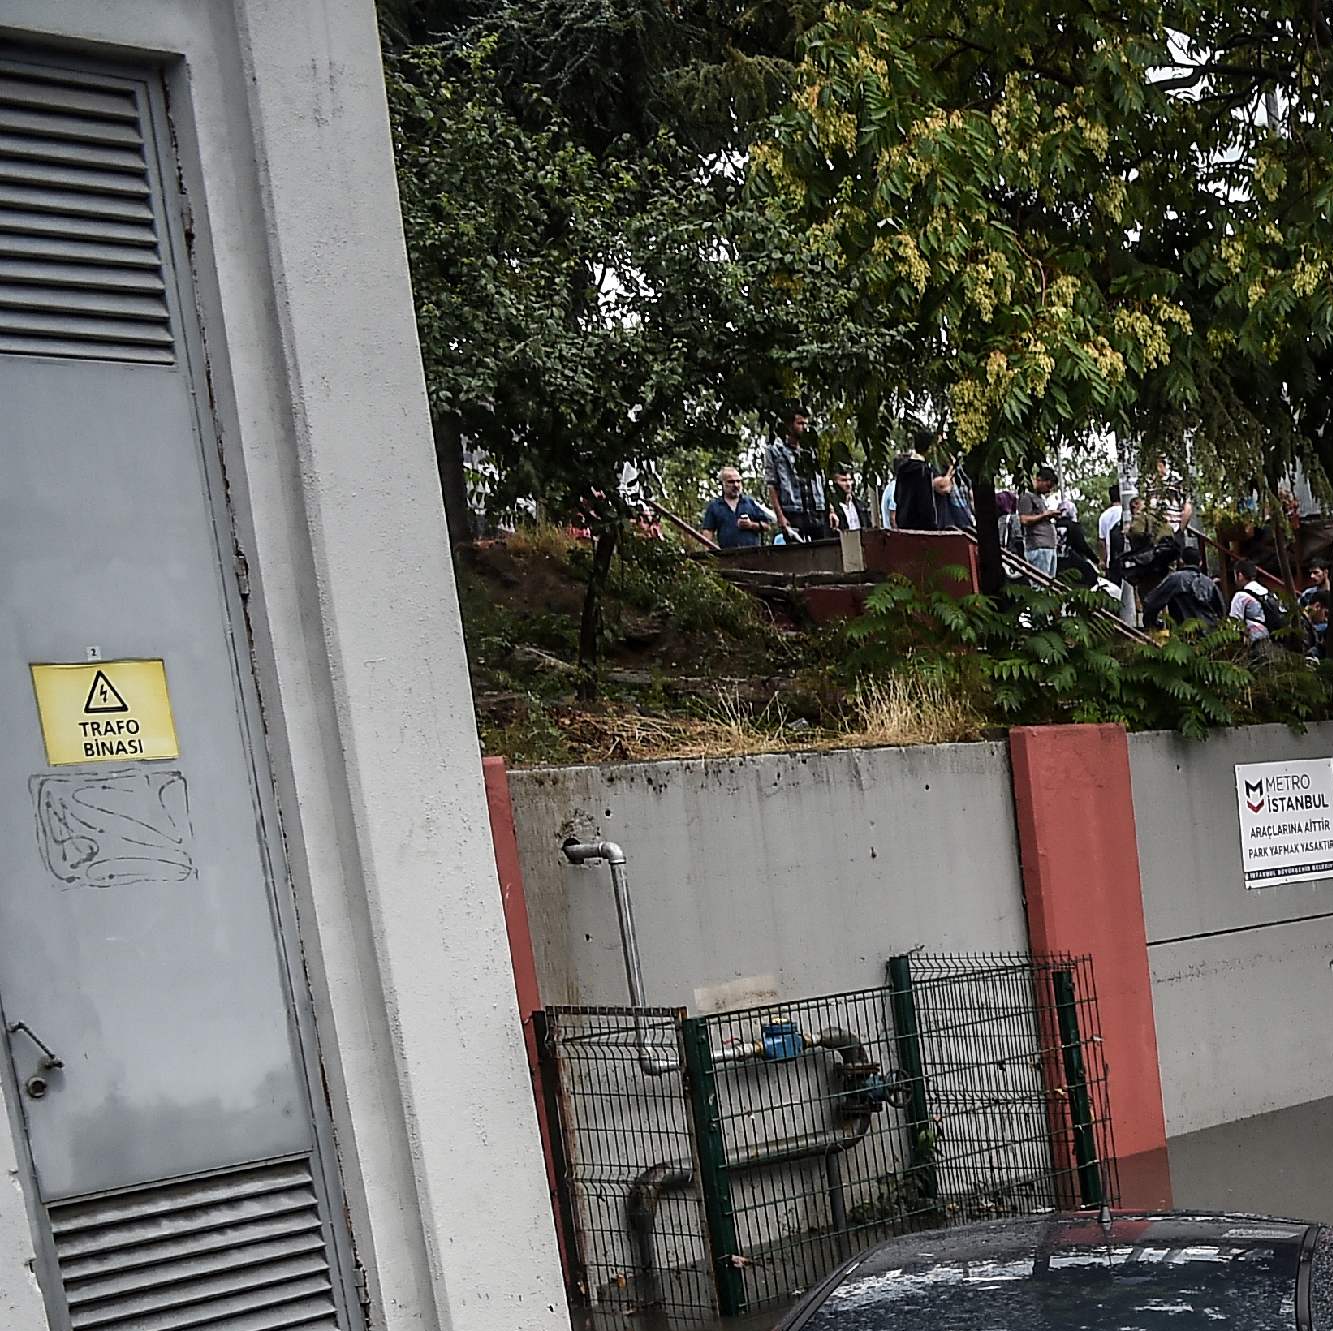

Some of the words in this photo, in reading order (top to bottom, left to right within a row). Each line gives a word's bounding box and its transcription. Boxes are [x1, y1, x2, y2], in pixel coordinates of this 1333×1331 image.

[78, 719, 140, 737] TRAFO
[83, 738, 144, 757] BİNASI
[1265, 774, 1310, 792] METRO
[1267, 793, 1329, 813] İSTANBUL
[1250, 821, 1303, 839] ARAÇLARINA
[1248, 847, 1268, 859] PARK
[1269, 843, 1300, 856] YAPMAK
